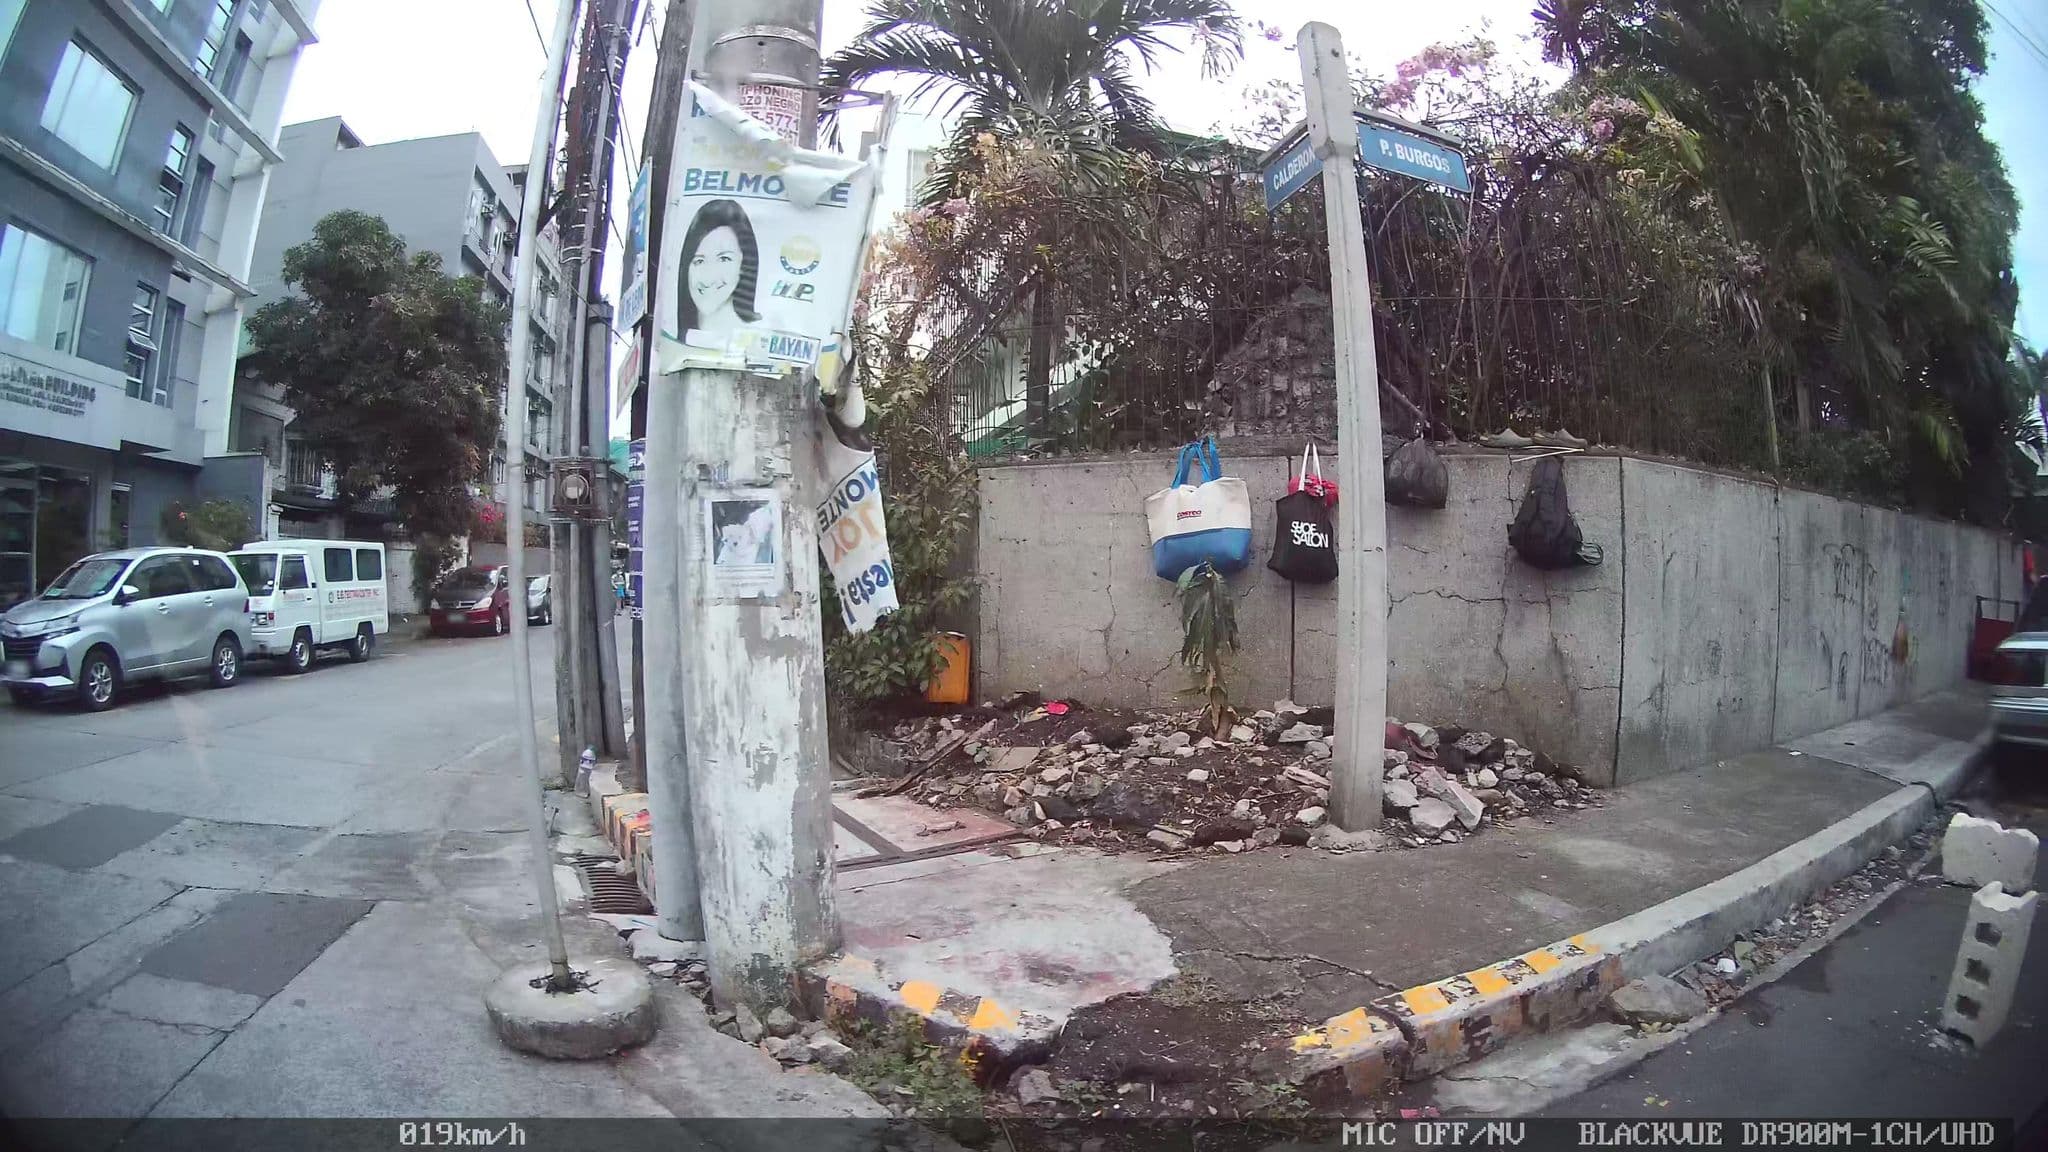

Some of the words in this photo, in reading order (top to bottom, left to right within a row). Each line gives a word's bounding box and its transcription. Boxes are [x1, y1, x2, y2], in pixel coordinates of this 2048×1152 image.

[740, 85, 801, 101] IPHONING
[1273, 146, 1315, 190] CALDERON
[1380, 138, 1392, 157] P.
[1396, 143, 1450, 173] BURGOS
[684, 168, 851, 203] BELMOE
[769, 335, 813, 359] BAYAN
[830, 503, 881, 566] JOY
[1290, 521, 1317, 534] SHOE
[1293, 532, 1329, 548] SALON
